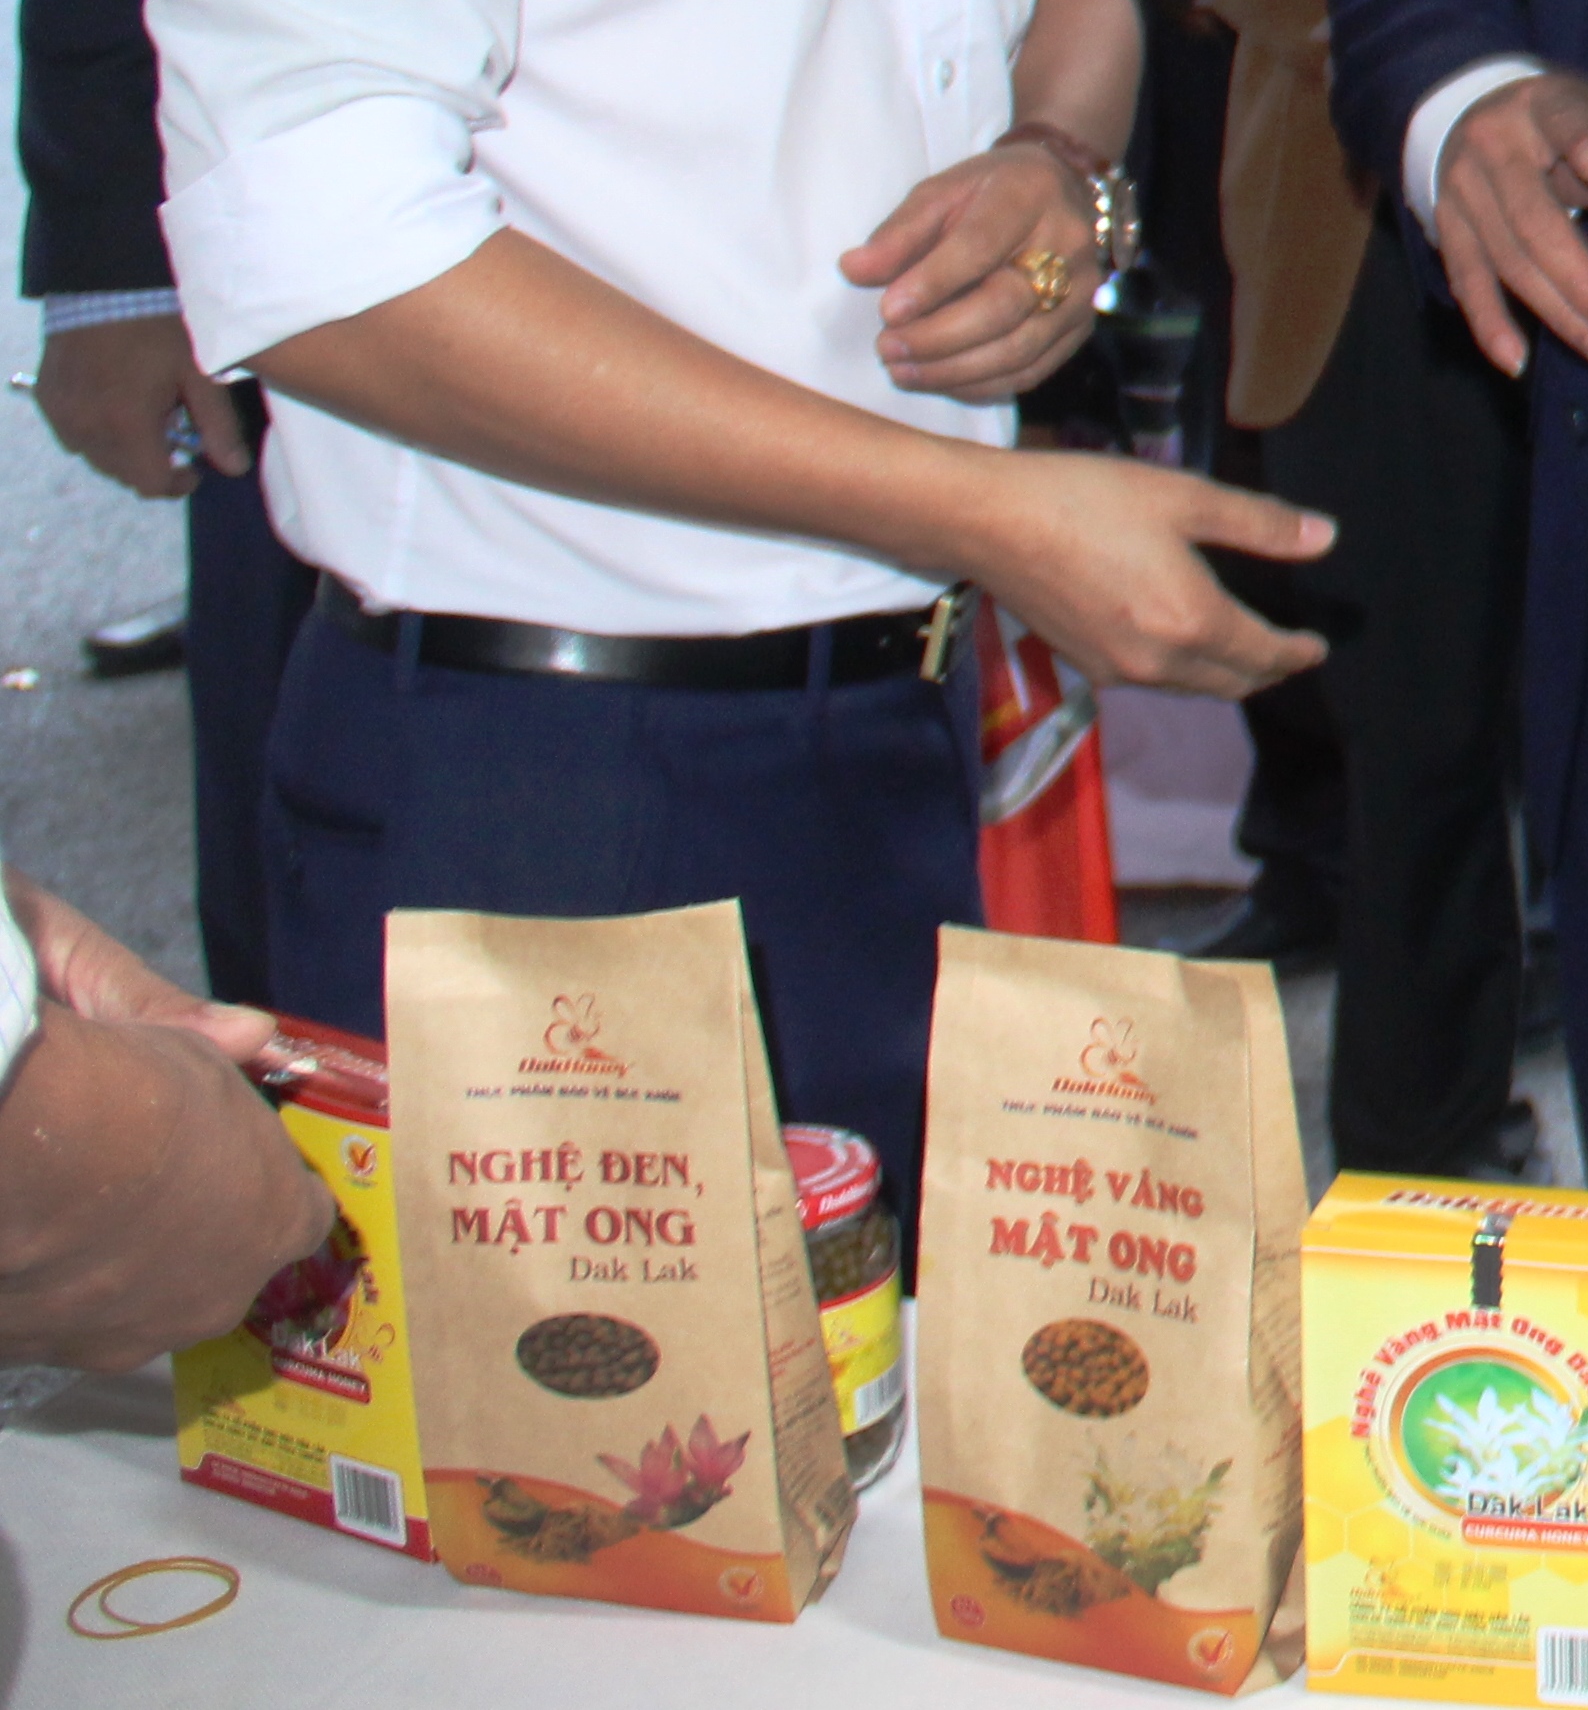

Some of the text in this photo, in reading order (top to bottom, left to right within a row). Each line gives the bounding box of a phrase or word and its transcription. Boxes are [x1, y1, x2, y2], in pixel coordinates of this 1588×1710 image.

[449, 1140, 704, 1198] NGHỆ ĐEN,
[984, 1154, 1097, 1206] NGHỆ
[451, 1196, 697, 1256] MẬT ONG
[988, 1209, 1198, 1284] MẬT ONG
[570, 1254, 699, 1283] Dak Lak
[1088, 1276, 1201, 1326] Dak Lak
[1373, 1319, 1442, 1368] Vàng
[1511, 1317, 1567, 1359] Ong
[1467, 1490, 1588, 1524] Dak Lak
